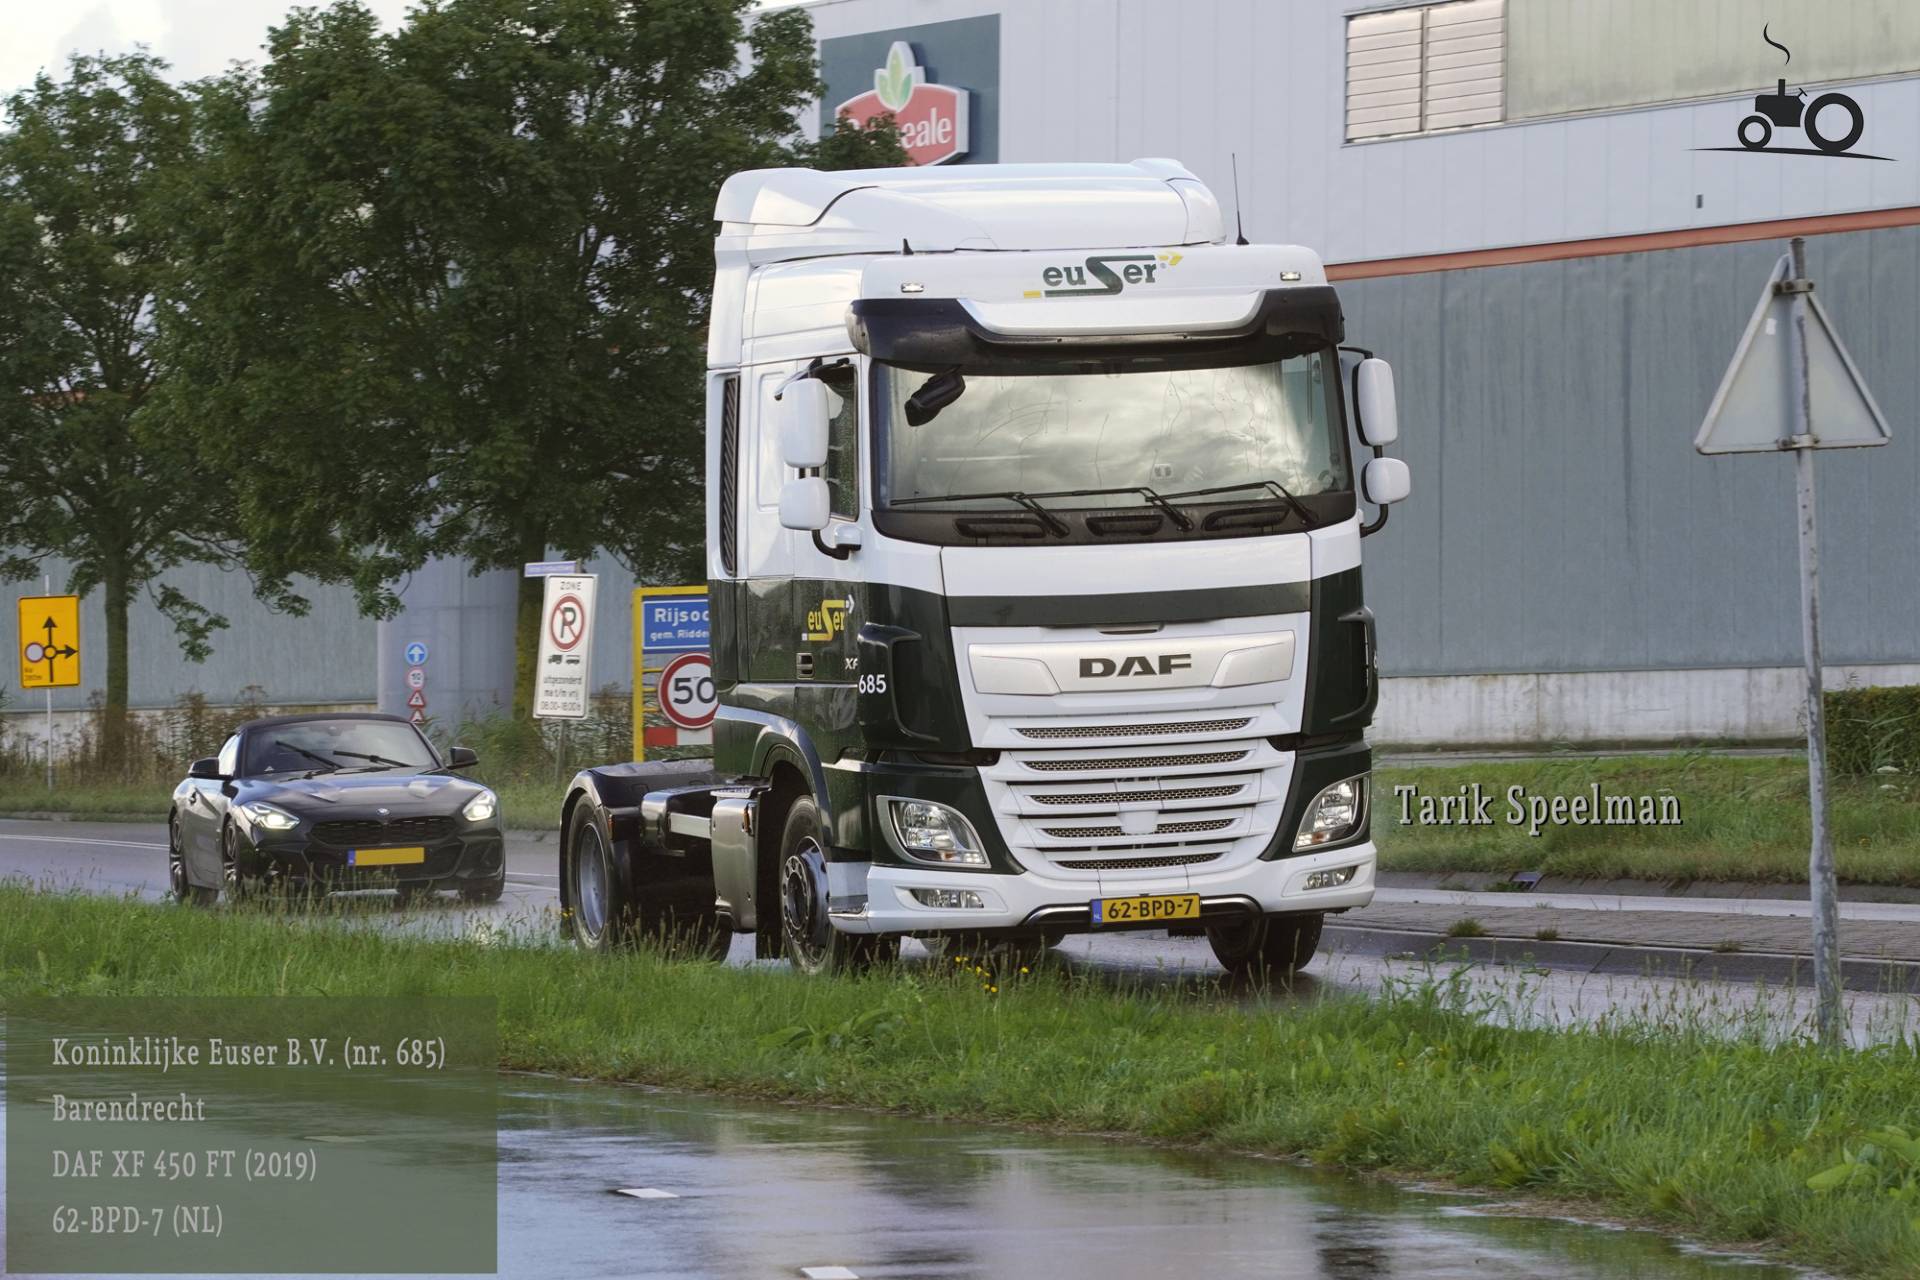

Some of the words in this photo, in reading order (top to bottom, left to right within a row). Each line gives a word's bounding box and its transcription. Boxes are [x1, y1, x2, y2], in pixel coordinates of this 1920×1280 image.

[844, 657, 858, 670] XF
[1079, 653, 1192, 678] DAF
[673, 677, 717, 704] 50
[858, 673, 887, 694] 685
[1108, 898, 1194, 919] 62-BPD-7
